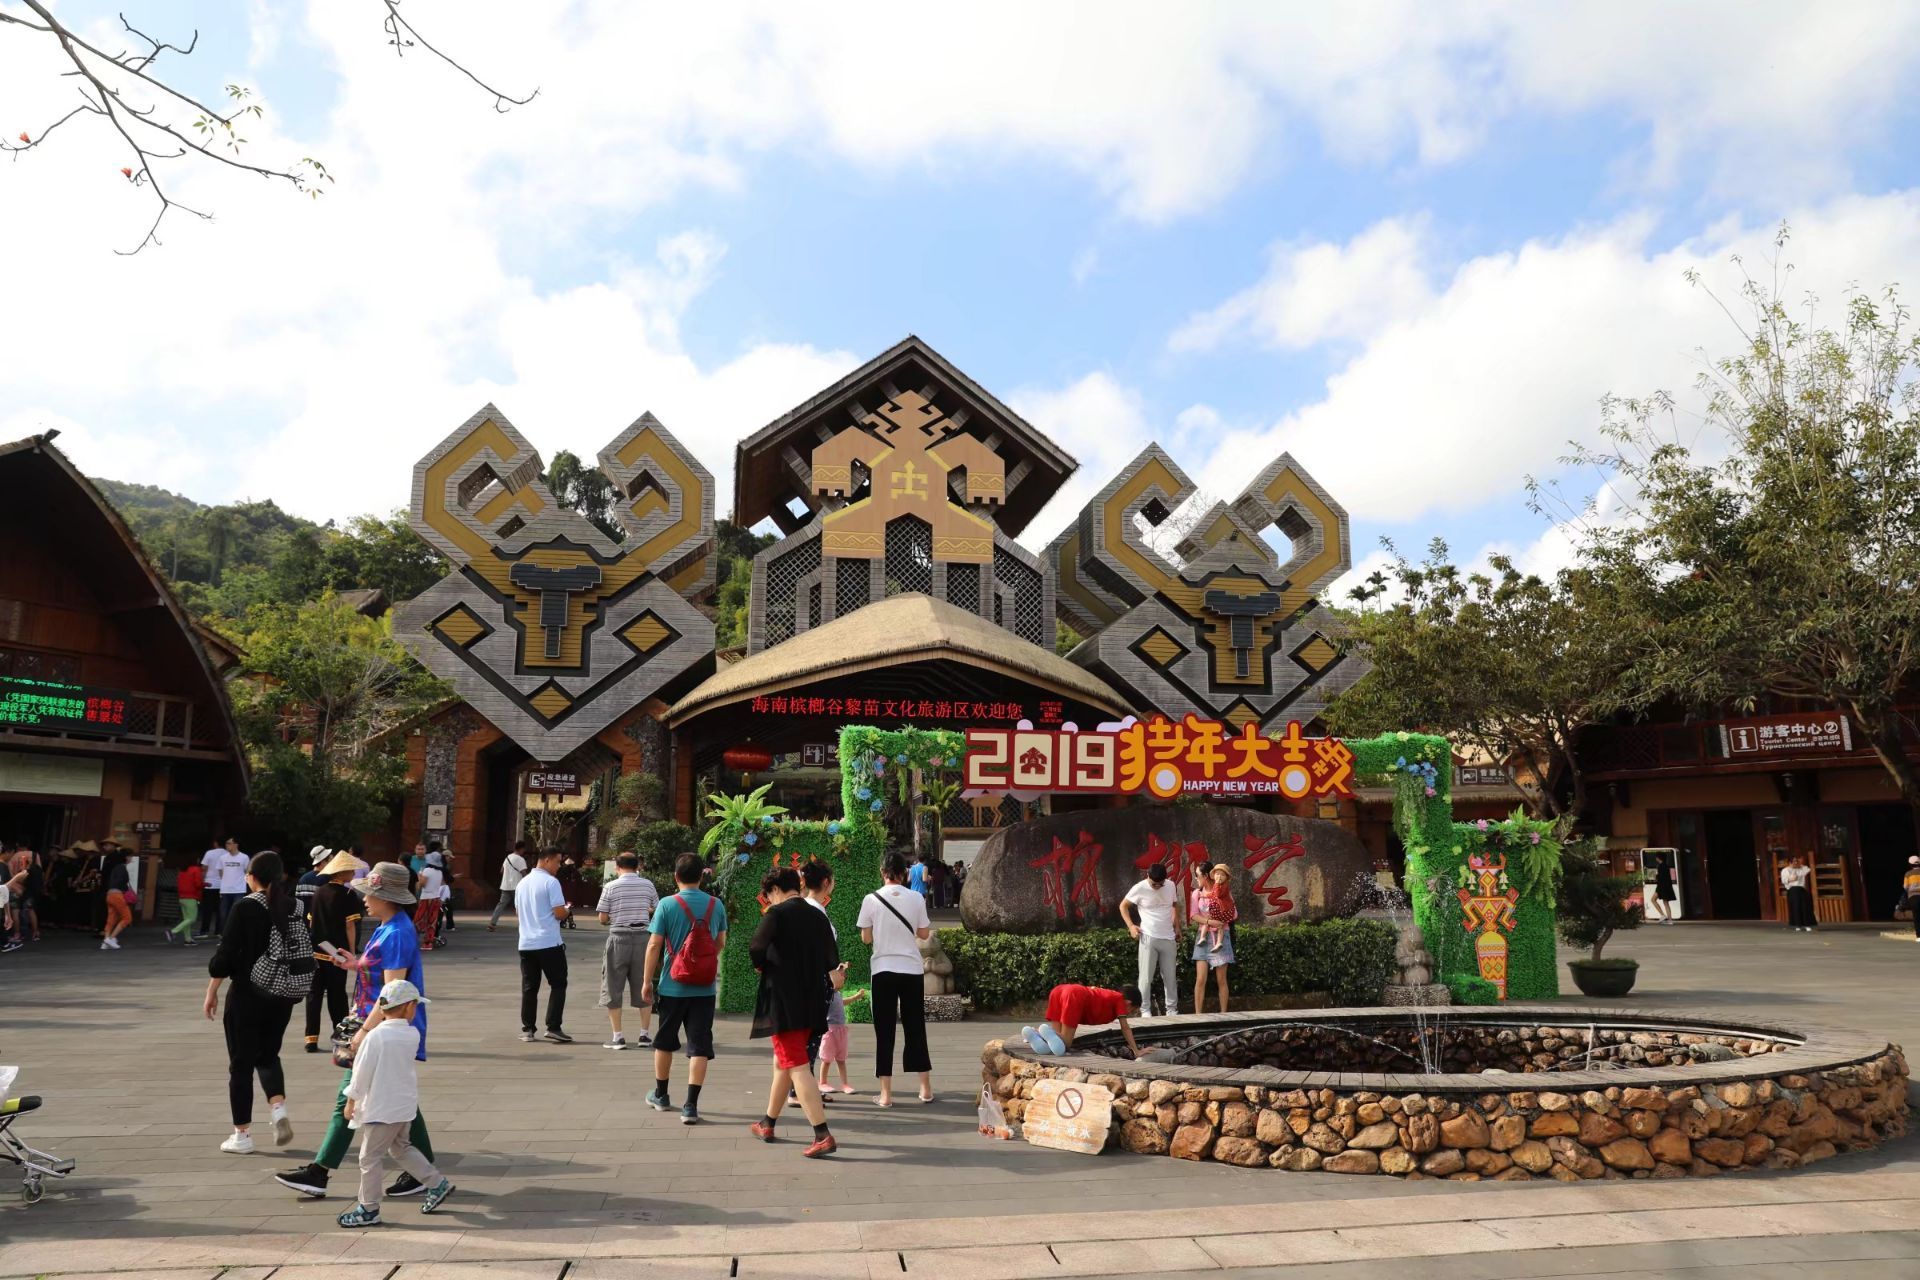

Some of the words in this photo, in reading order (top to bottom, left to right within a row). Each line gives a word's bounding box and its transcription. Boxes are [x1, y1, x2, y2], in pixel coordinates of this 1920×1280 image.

[751, 695, 1023, 719] 海南槟榔谷黎苗文化旅游区欢迎您
[967, 732, 1116, 789] 2019
[1119, 716, 1312, 798] 猪年大吉
[1183, 780, 1220, 791] HAPPY
[1223, 781, 1247, 792] NEW
[1250, 782, 1279, 792] YEAR
